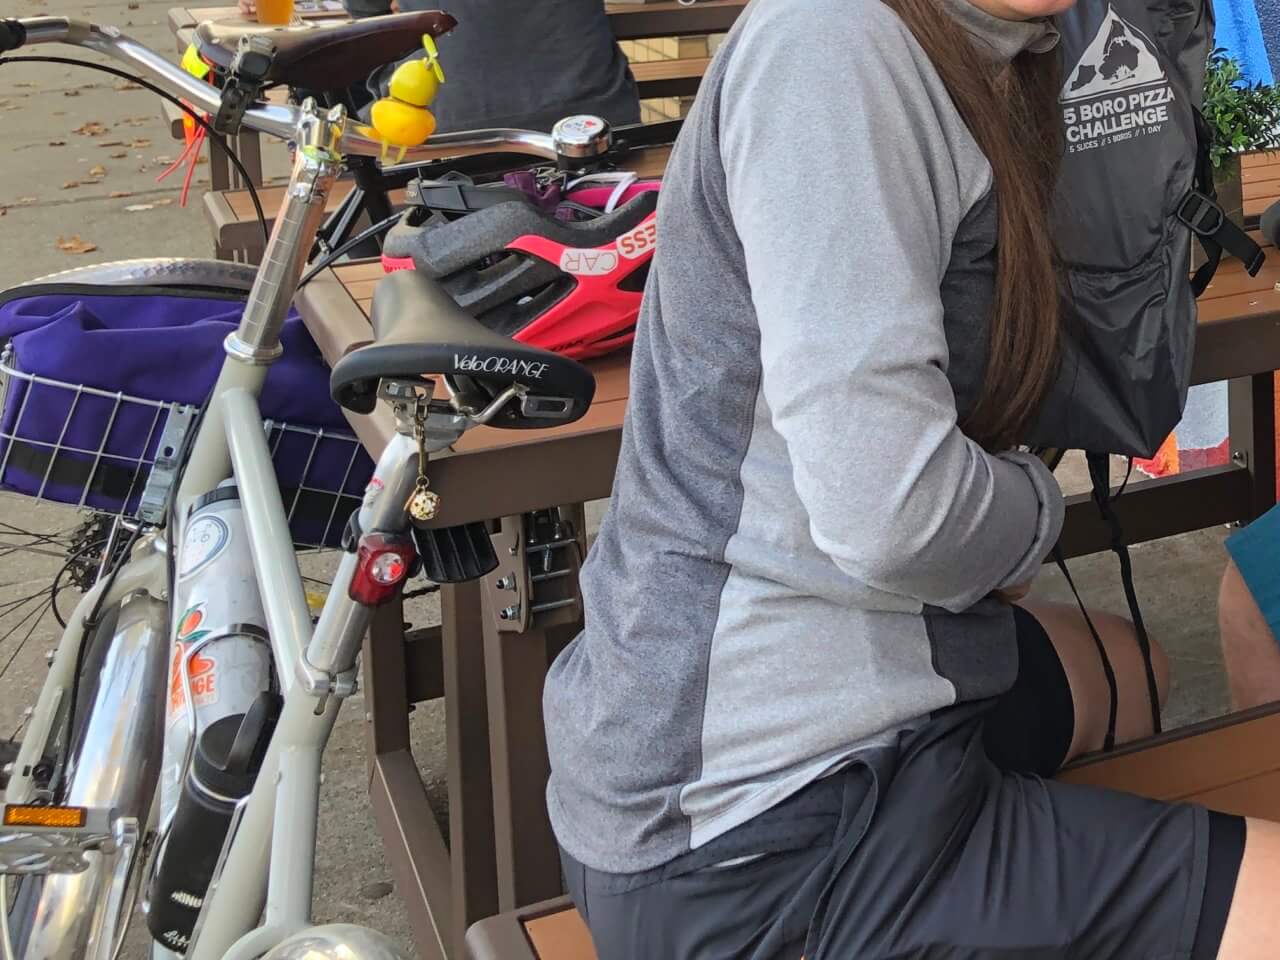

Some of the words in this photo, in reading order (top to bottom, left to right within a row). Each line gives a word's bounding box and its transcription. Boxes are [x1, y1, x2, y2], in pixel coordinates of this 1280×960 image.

[1063, 108, 1077, 125] 5
[1080, 97, 1127, 122] BORO
[1129, 86, 1176, 110] PIZZA
[1066, 105, 1169, 143] CHALLENGE
[1077, 140, 1099, 152] SLICES
[1148, 125, 1162, 135] DAY
[564, 250, 617, 273] CAR
